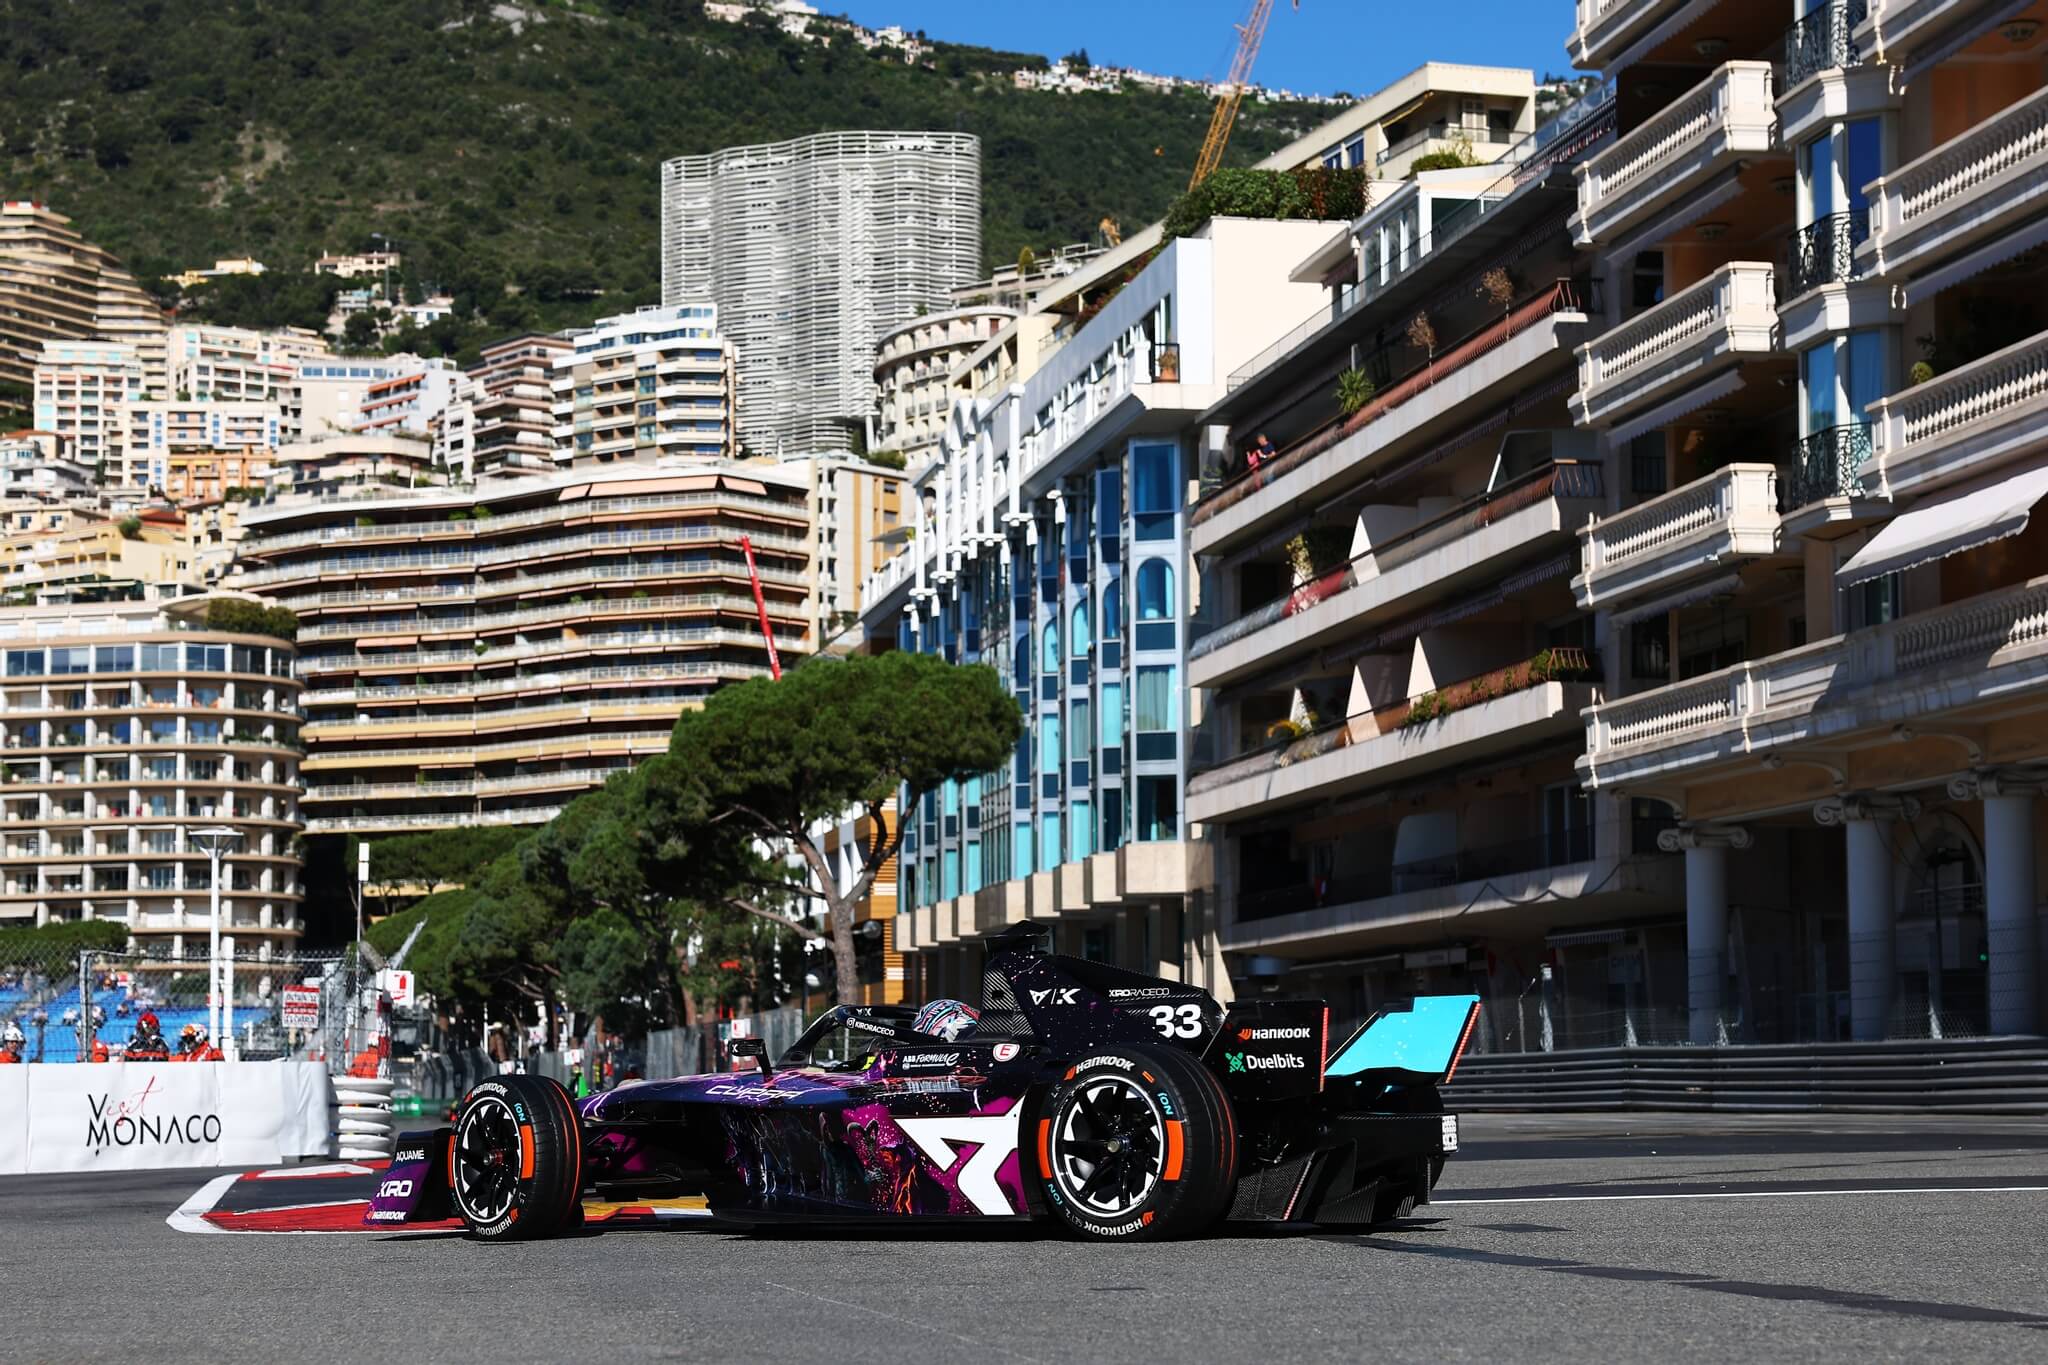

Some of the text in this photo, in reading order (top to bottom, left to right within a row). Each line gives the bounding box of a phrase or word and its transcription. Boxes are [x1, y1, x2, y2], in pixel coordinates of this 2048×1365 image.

[1149, 1004, 1203, 1039] 33
[1000, 1044, 1011, 1056] E
[1246, 1053, 1305, 1070] Duelbits
[88, 1076, 164, 1127] Visit
[705, 1085, 805, 1101] CUPRA
[86, 1114, 222, 1148] MONACO
